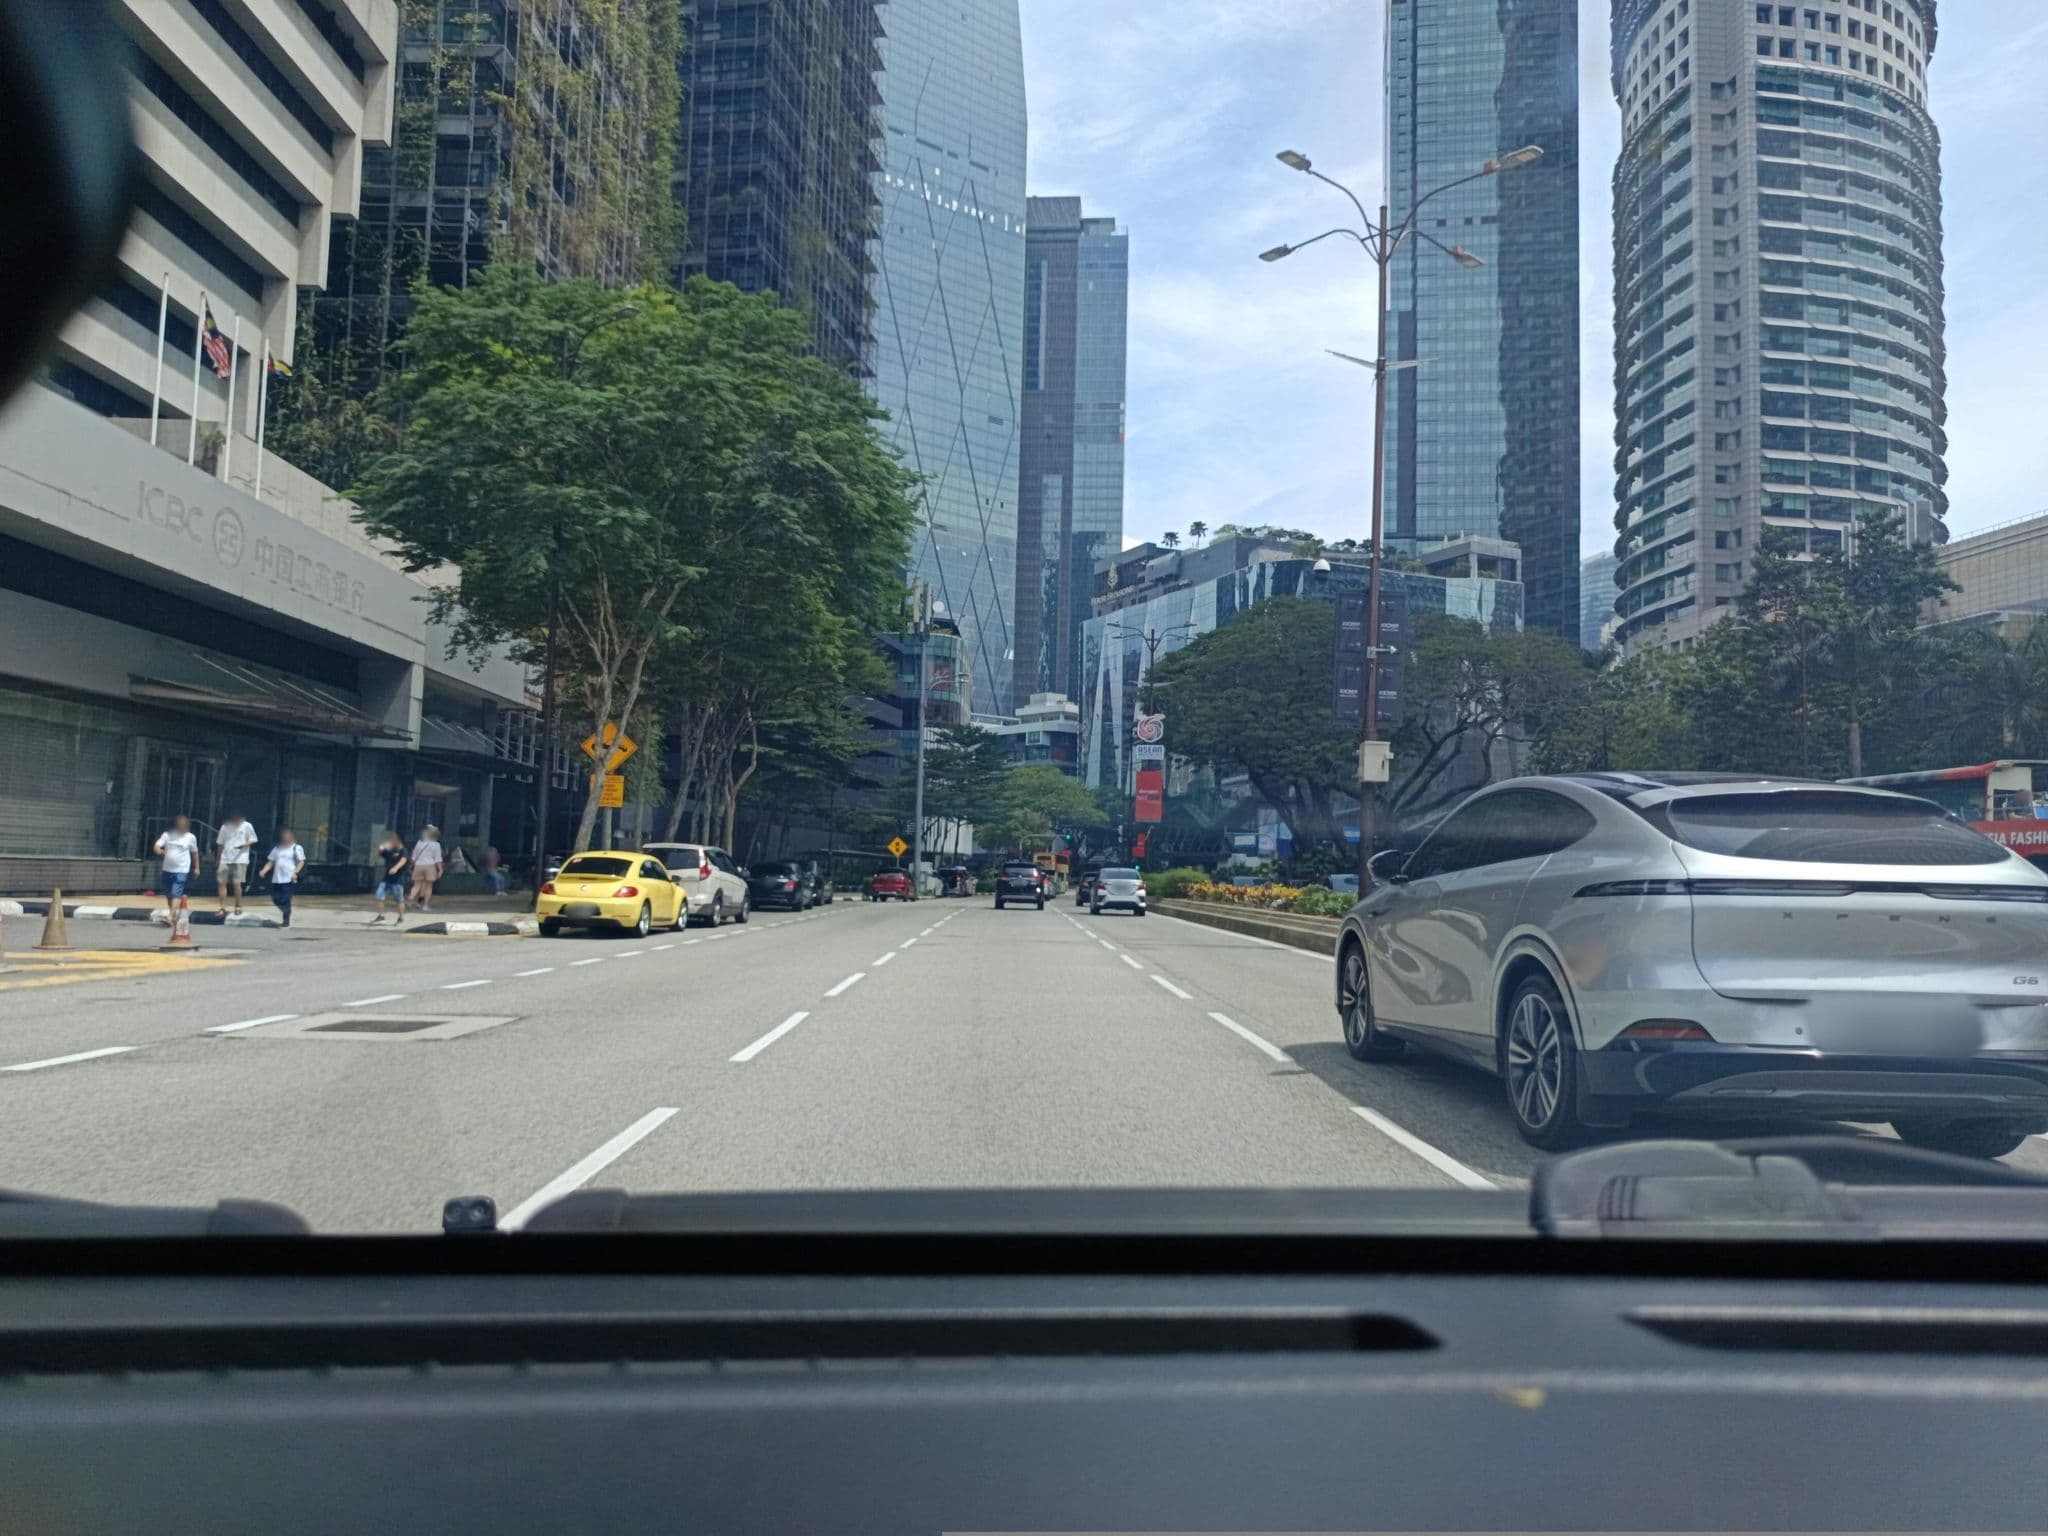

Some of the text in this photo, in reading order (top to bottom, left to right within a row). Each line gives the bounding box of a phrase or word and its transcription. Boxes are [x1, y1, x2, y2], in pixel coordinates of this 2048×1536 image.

[136, 480, 203, 544] ICBC
[2010, 831, 2048, 845] FASHI
[2012, 975, 2040, 986] G6
